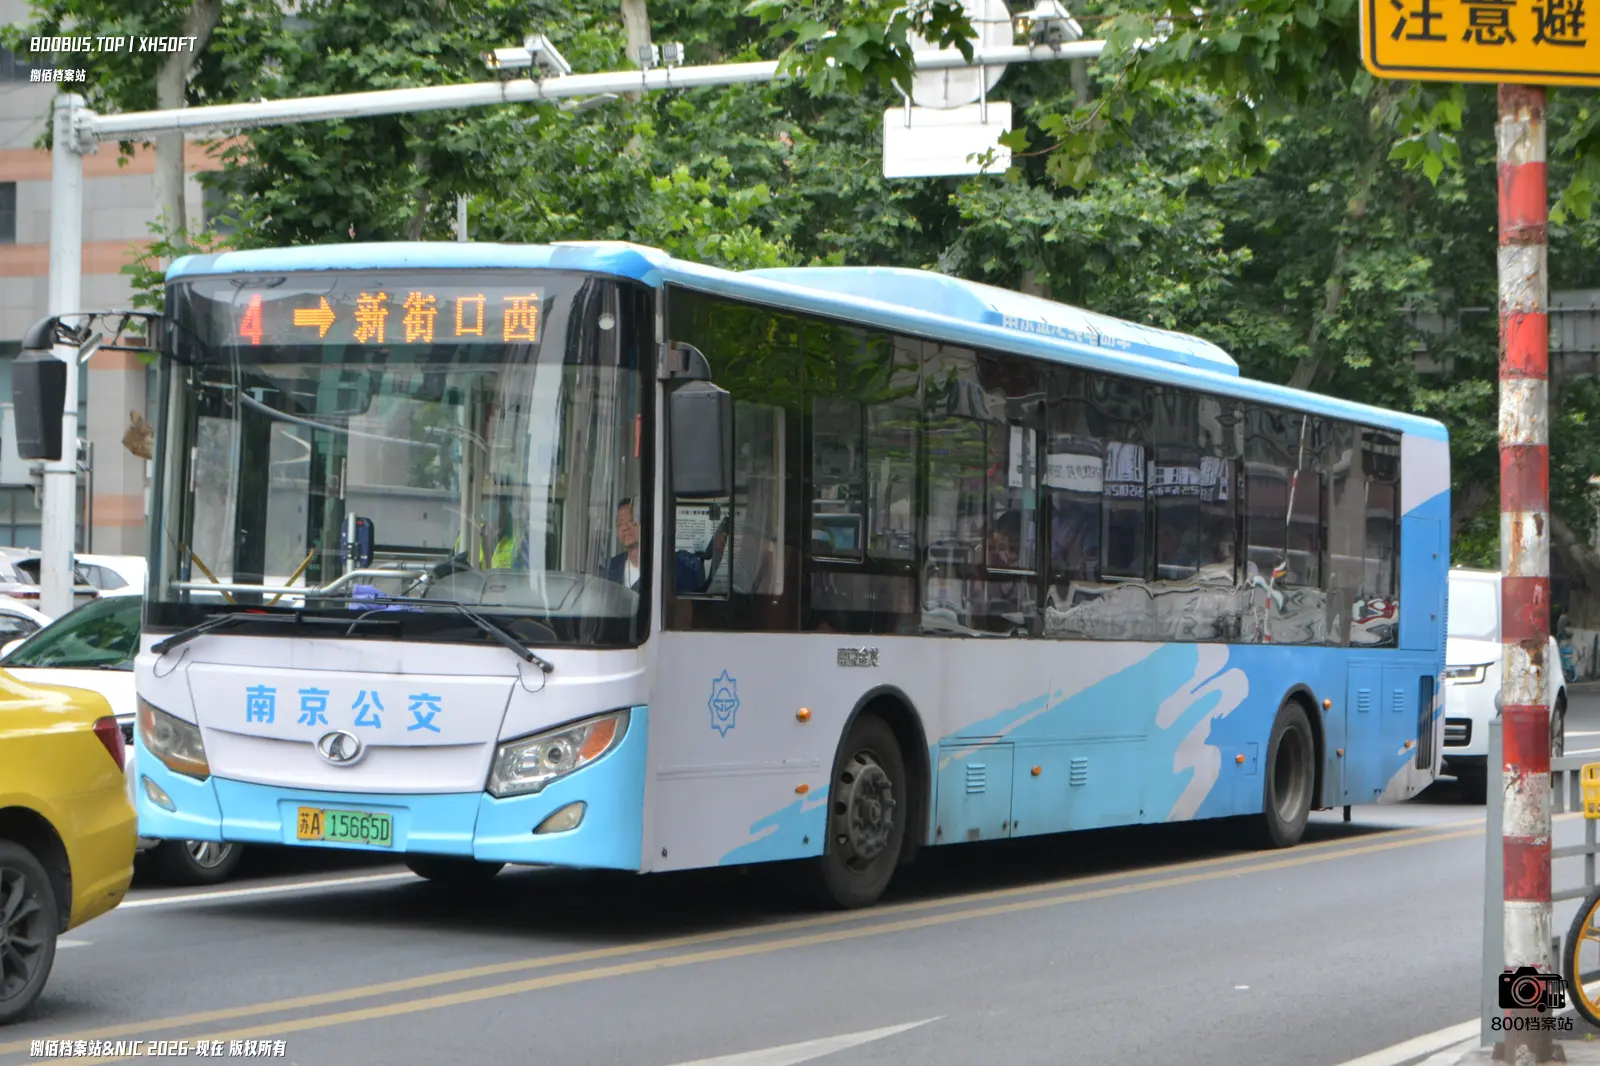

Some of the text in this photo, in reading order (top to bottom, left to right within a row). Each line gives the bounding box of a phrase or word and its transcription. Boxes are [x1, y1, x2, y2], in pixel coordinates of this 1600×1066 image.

[1390, 0, 1588, 48] 注意避
[239, 292, 539, 345] 4 新街口西
[245, 684, 443, 733] 南京公交
